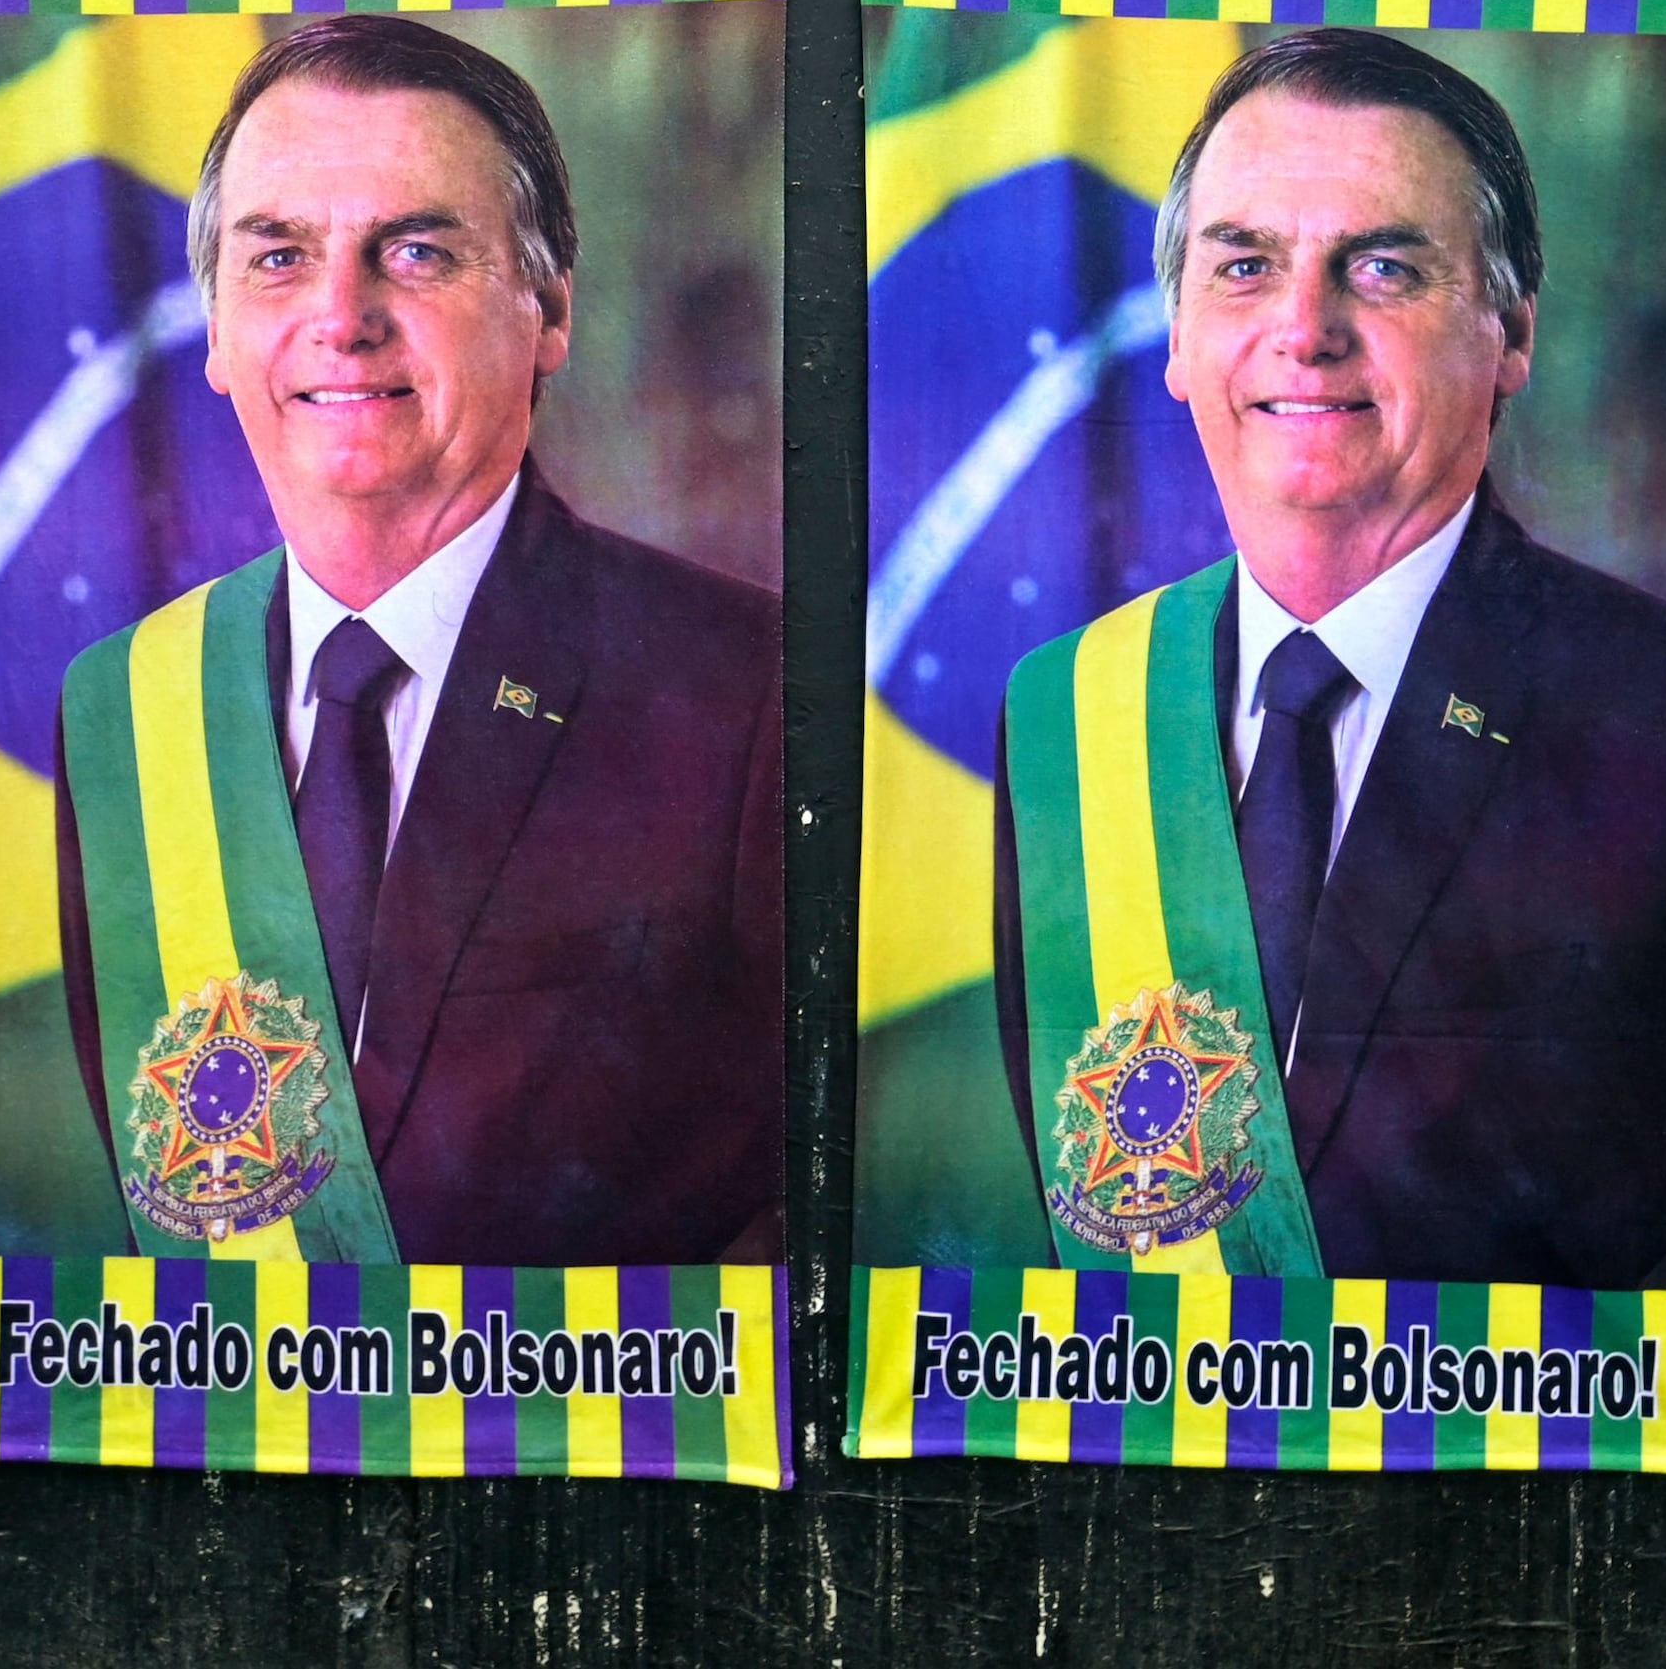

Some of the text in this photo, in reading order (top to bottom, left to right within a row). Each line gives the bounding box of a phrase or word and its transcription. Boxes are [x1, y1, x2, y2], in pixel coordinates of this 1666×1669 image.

[257, 1208, 273, 1225] DE
[1182, 1222, 1198, 1238] DE
[266, 1323, 392, 1396] com
[408, 1308, 739, 1398] Bolsonaro!
[911, 1311, 1658, 1419] Fechado com Bolsonaro!
